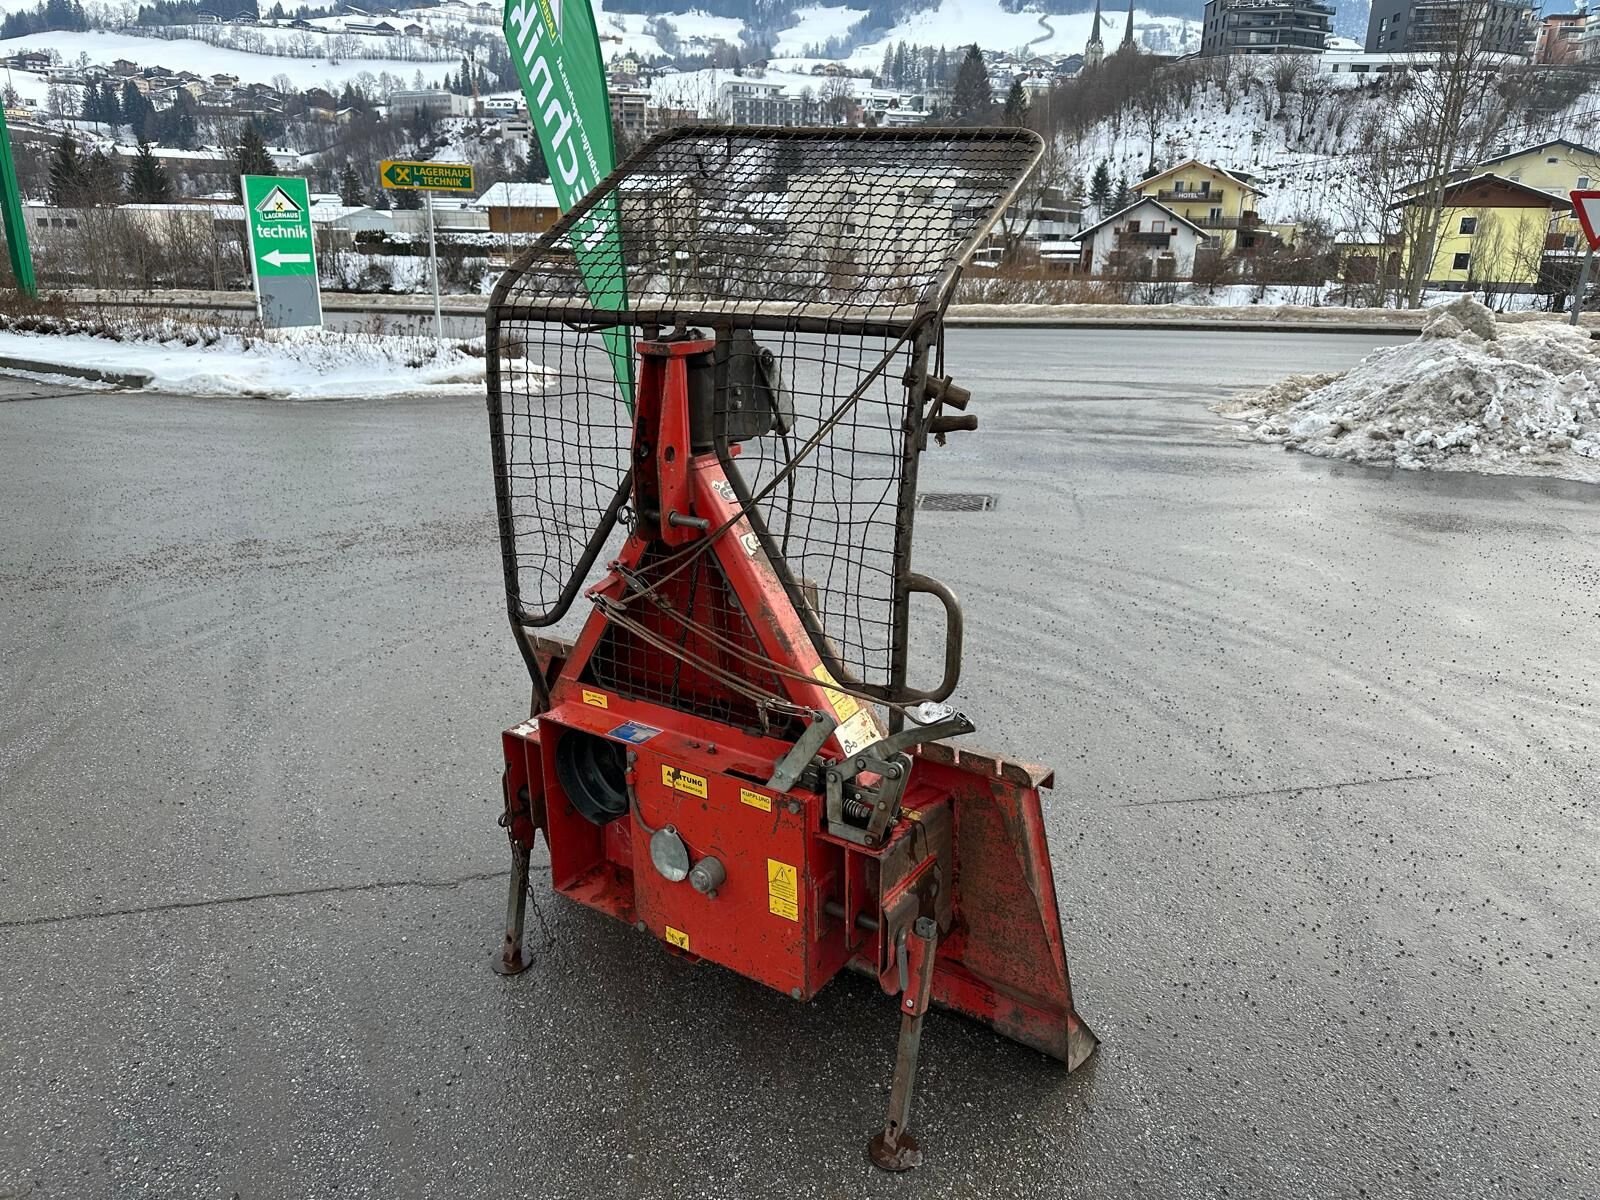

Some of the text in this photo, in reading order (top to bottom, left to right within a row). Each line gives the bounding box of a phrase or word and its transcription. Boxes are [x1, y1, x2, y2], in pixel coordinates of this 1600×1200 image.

[413, 166, 470, 178] LAGERHAUS
[422, 176, 463, 187] TECHNIK
[264, 211, 298, 220] LAGERHAUS
[256, 223, 308, 239] technik
[742, 790, 770, 804] KUPPLUNG
